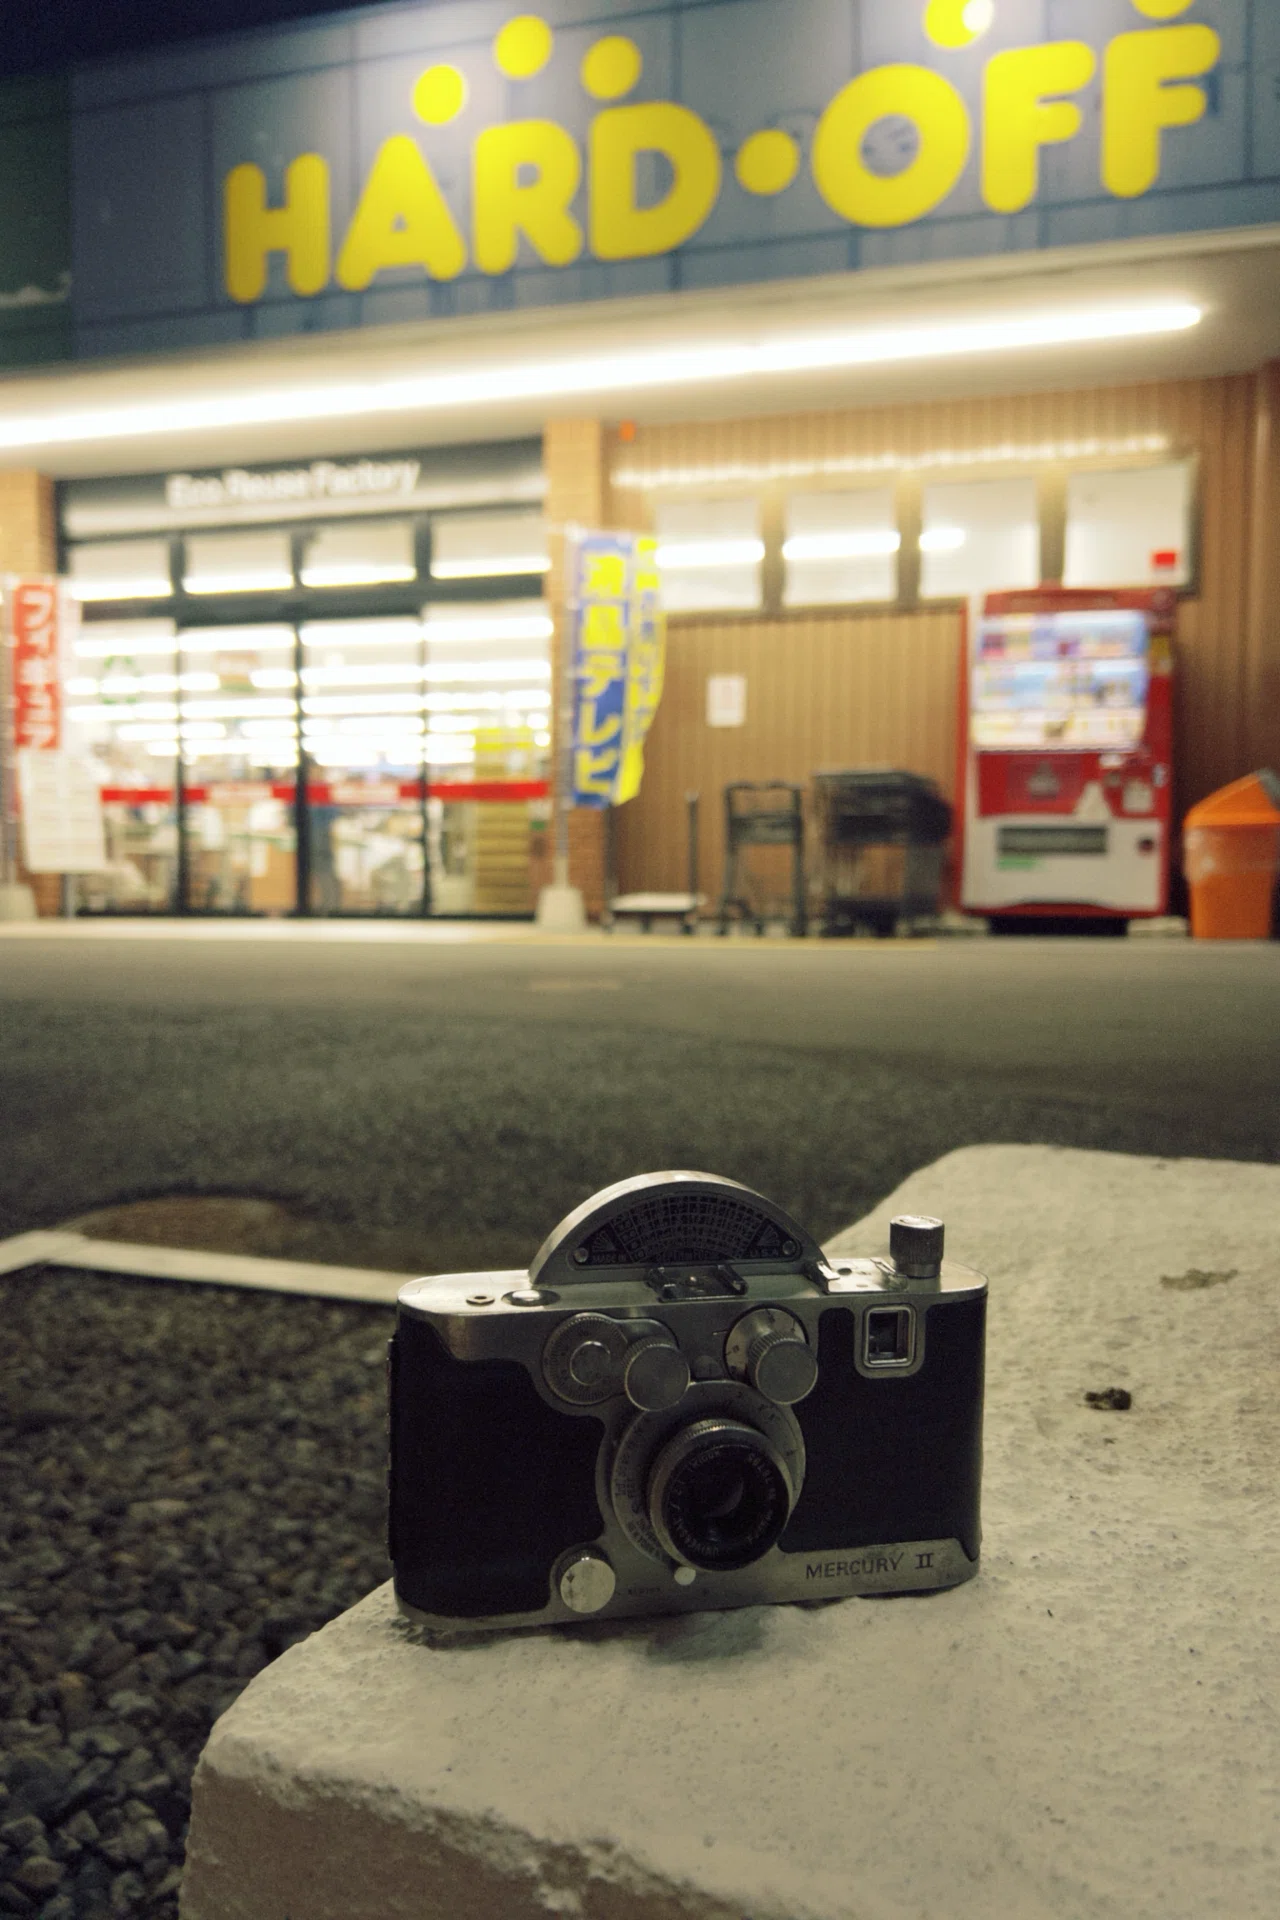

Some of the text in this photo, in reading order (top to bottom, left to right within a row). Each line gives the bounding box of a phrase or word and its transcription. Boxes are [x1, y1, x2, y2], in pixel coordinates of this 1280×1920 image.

[311, 460, 421, 499] Factory
[805, 1551, 935, 1580] MERCURY II
